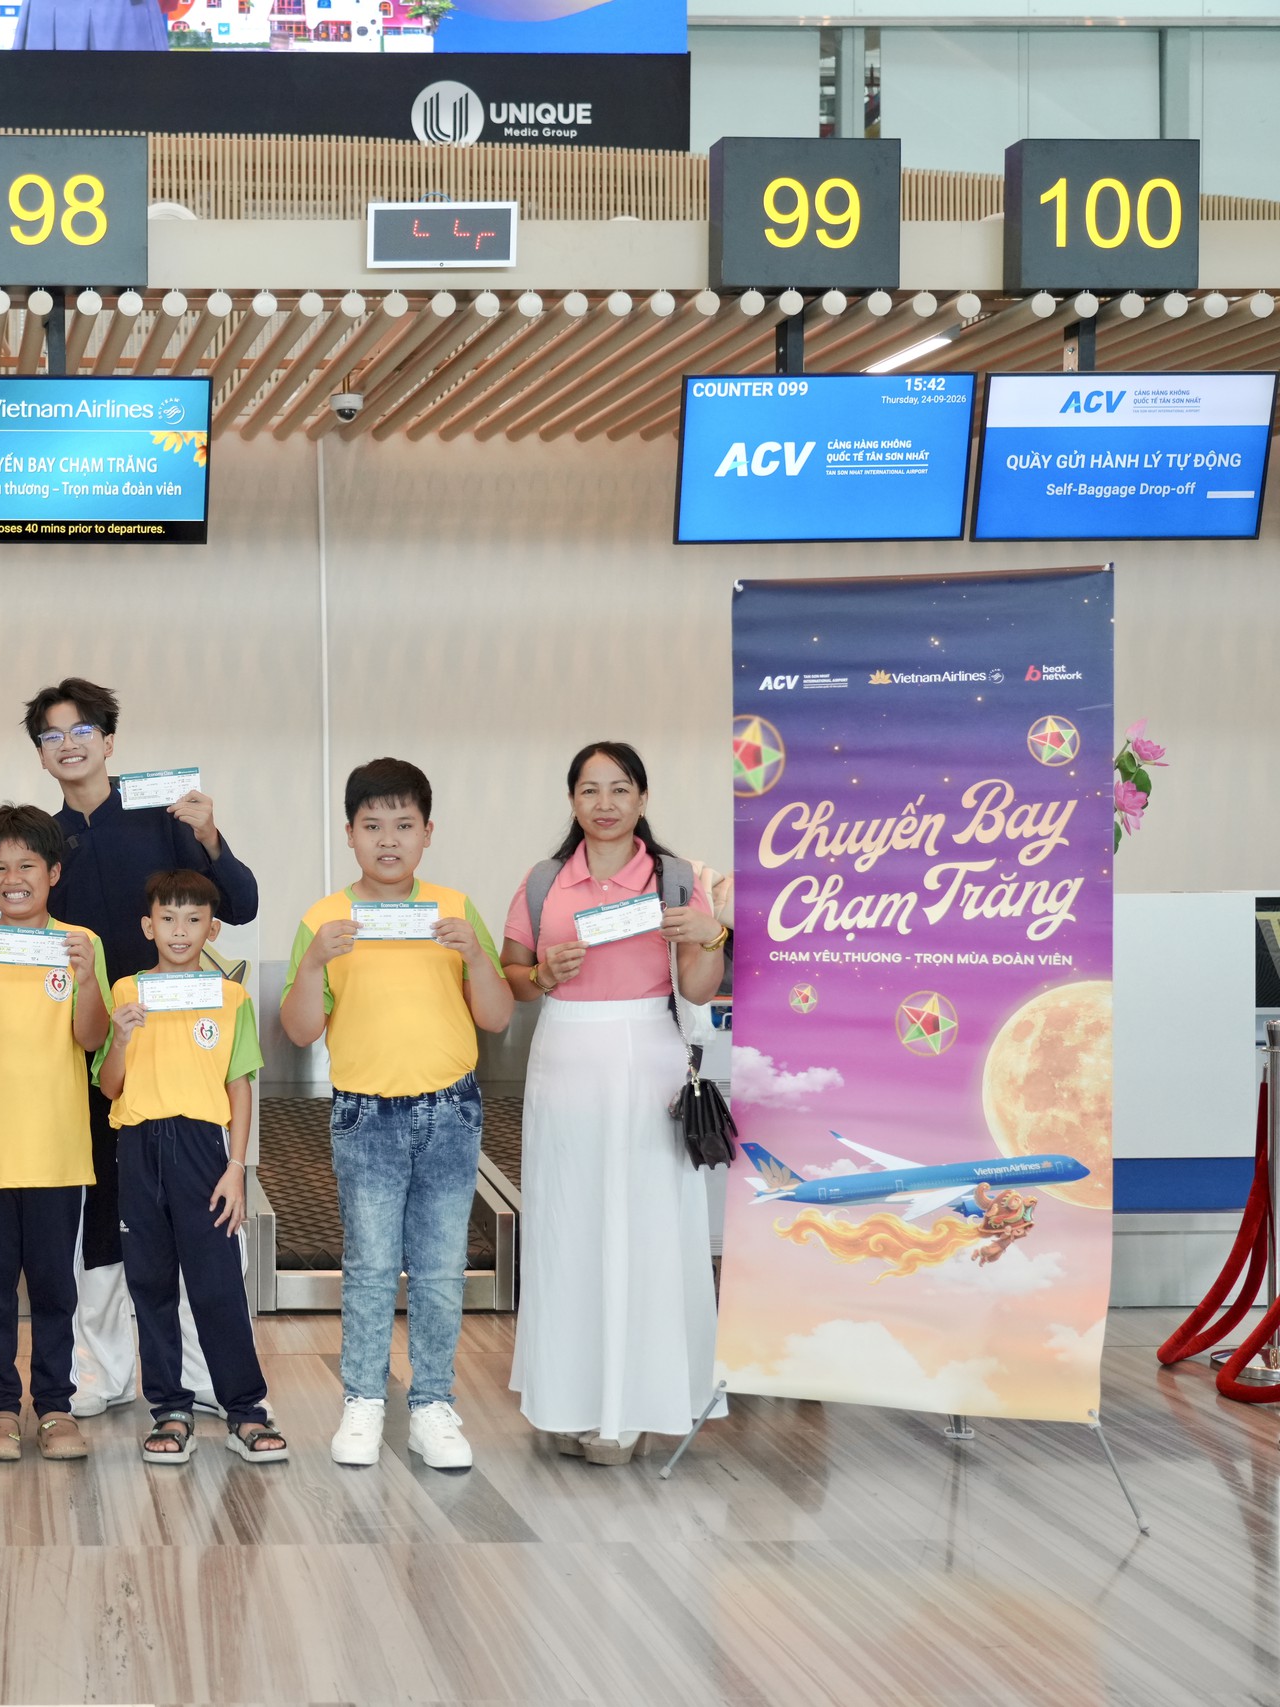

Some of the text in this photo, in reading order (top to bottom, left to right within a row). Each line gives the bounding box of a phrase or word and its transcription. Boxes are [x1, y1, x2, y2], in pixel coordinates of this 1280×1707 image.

[490, 103, 592, 124] UNIQUE
[504, 127, 578, 138] Media Group
[7, 173, 108, 246] 98
[762, 177, 862, 250] 99
[1038, 177, 1183, 250] 100
[692, 381, 809, 398] COUNTER 099
[905, 377, 946, 392] 15:42
[881, 395, 967, 406] Thursday, 24-09-2026
[1059, 390, 1127, 414] ACV
[827, 438, 912, 449] CẢNG HÀNG KHÔNG
[714, 441, 816, 477] ACV
[826, 449, 930, 463] QUỐC TẾ TÂN SƠN NHẤT
[1006, 449, 1242, 471] QUẦY GỬI HÀNH LÝ TỰ ĐỘNG
[27, 457, 56, 473] BAY
[59, 457, 104, 477] CHẠM
[106, 454, 158, 473] TRĂNG
[4, 481, 50, 498] thương
[61, 481, 90, 498] Trọn
[91, 482, 119, 496] mùa
[122, 481, 153, 496] đoàn
[155, 481, 182, 496] viên
[1046, 482, 1197, 498] Self-Baggage Drop-off
[25, 523, 39, 534] 40
[40, 523, 66, 534] mins
[68, 523, 93, 536] prior
[94, 524, 106, 535] to
[107, 523, 166, 536] departures.
[1042, 665, 1066, 673] beat
[1042, 672, 1082, 681] network
[759, 675, 799, 690] ACV
[758, 778, 1078, 873] Chuyến Bay
[767, 857, 1085, 942] Chạm Trăng
[769, 949, 1073, 967] CHẠM YÊU THƯƠNG TRỌN MÙA ĐOÀN VIÊN
